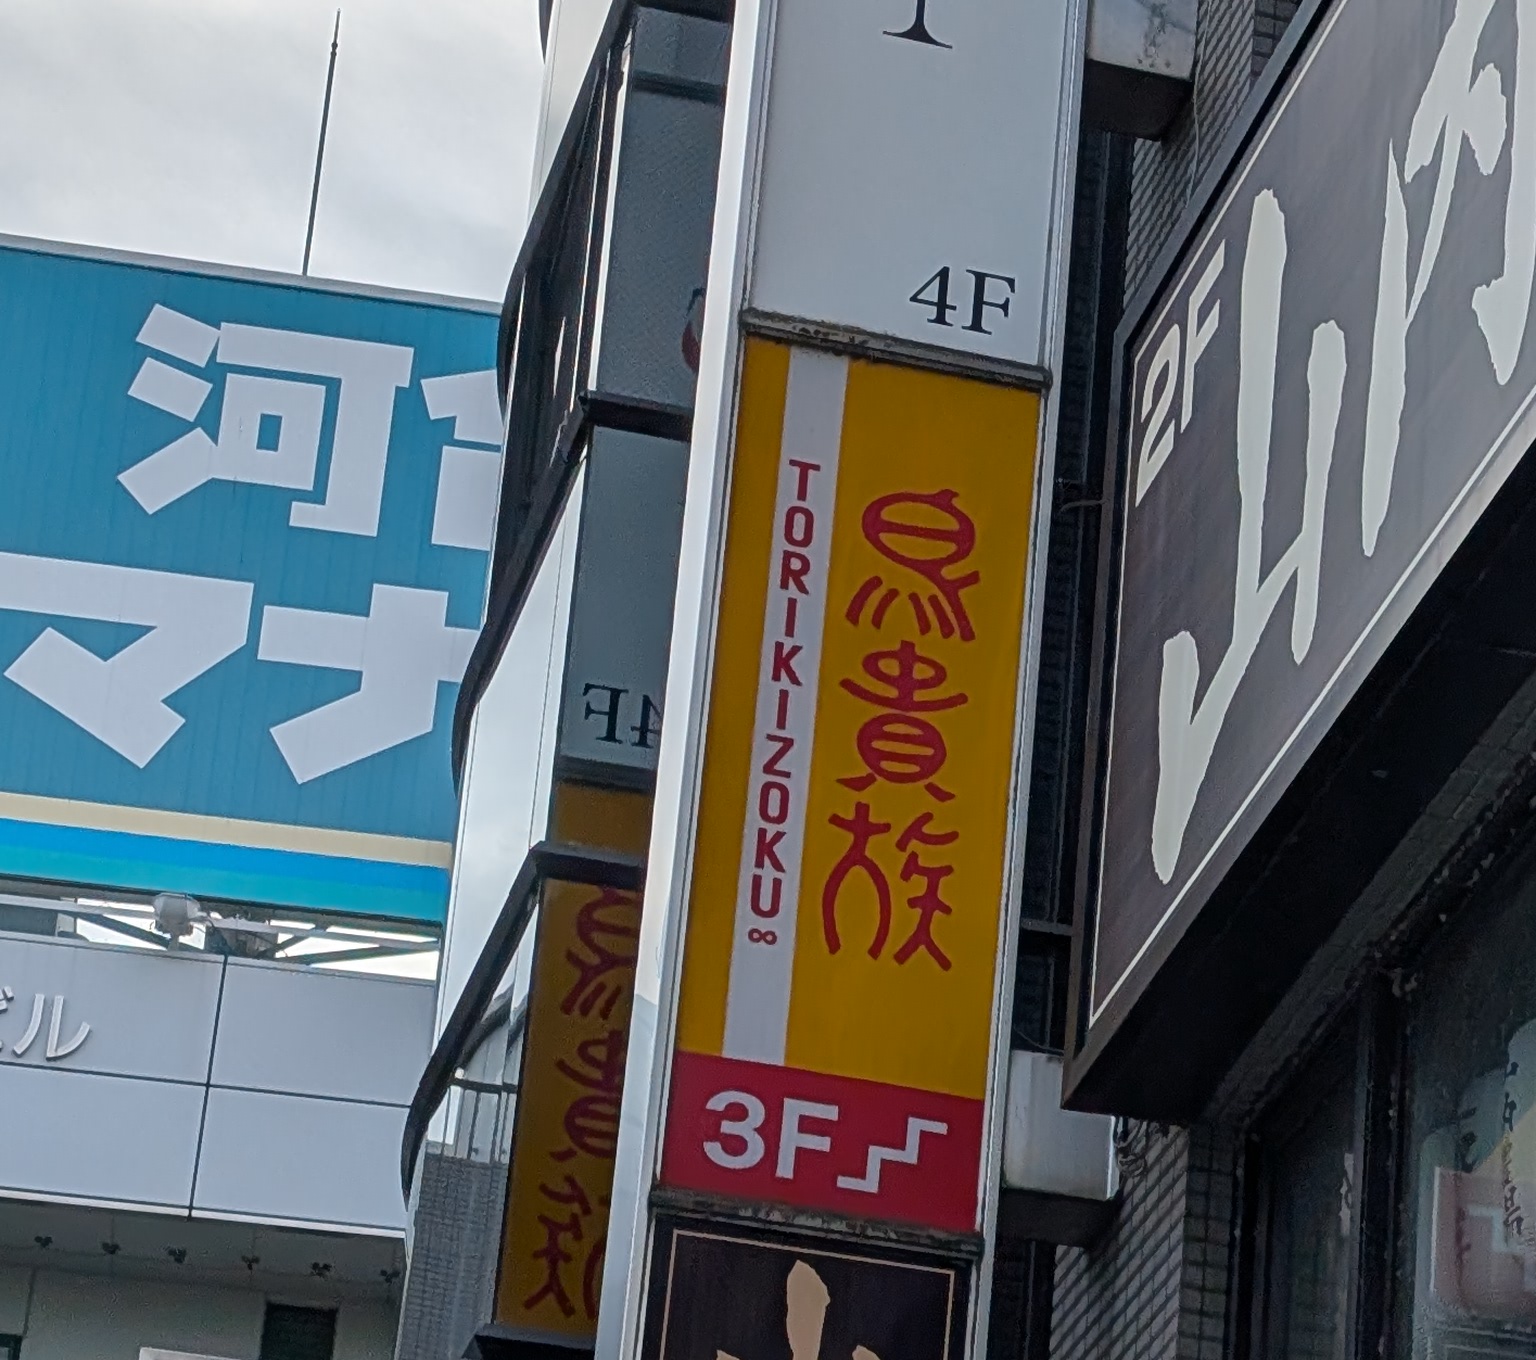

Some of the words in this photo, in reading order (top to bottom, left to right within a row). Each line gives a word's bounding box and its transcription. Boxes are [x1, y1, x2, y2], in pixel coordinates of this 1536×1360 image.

[909, 266, 1016, 335] 4F
[1134, 240, 1226, 507] 2F
[750, 459, 820, 919] TORIKIZOKU
[822, 490, 980, 971] 鳥貴族
[0, 986, 91, 1059] ル
[703, 1089, 845, 1179] 3F
